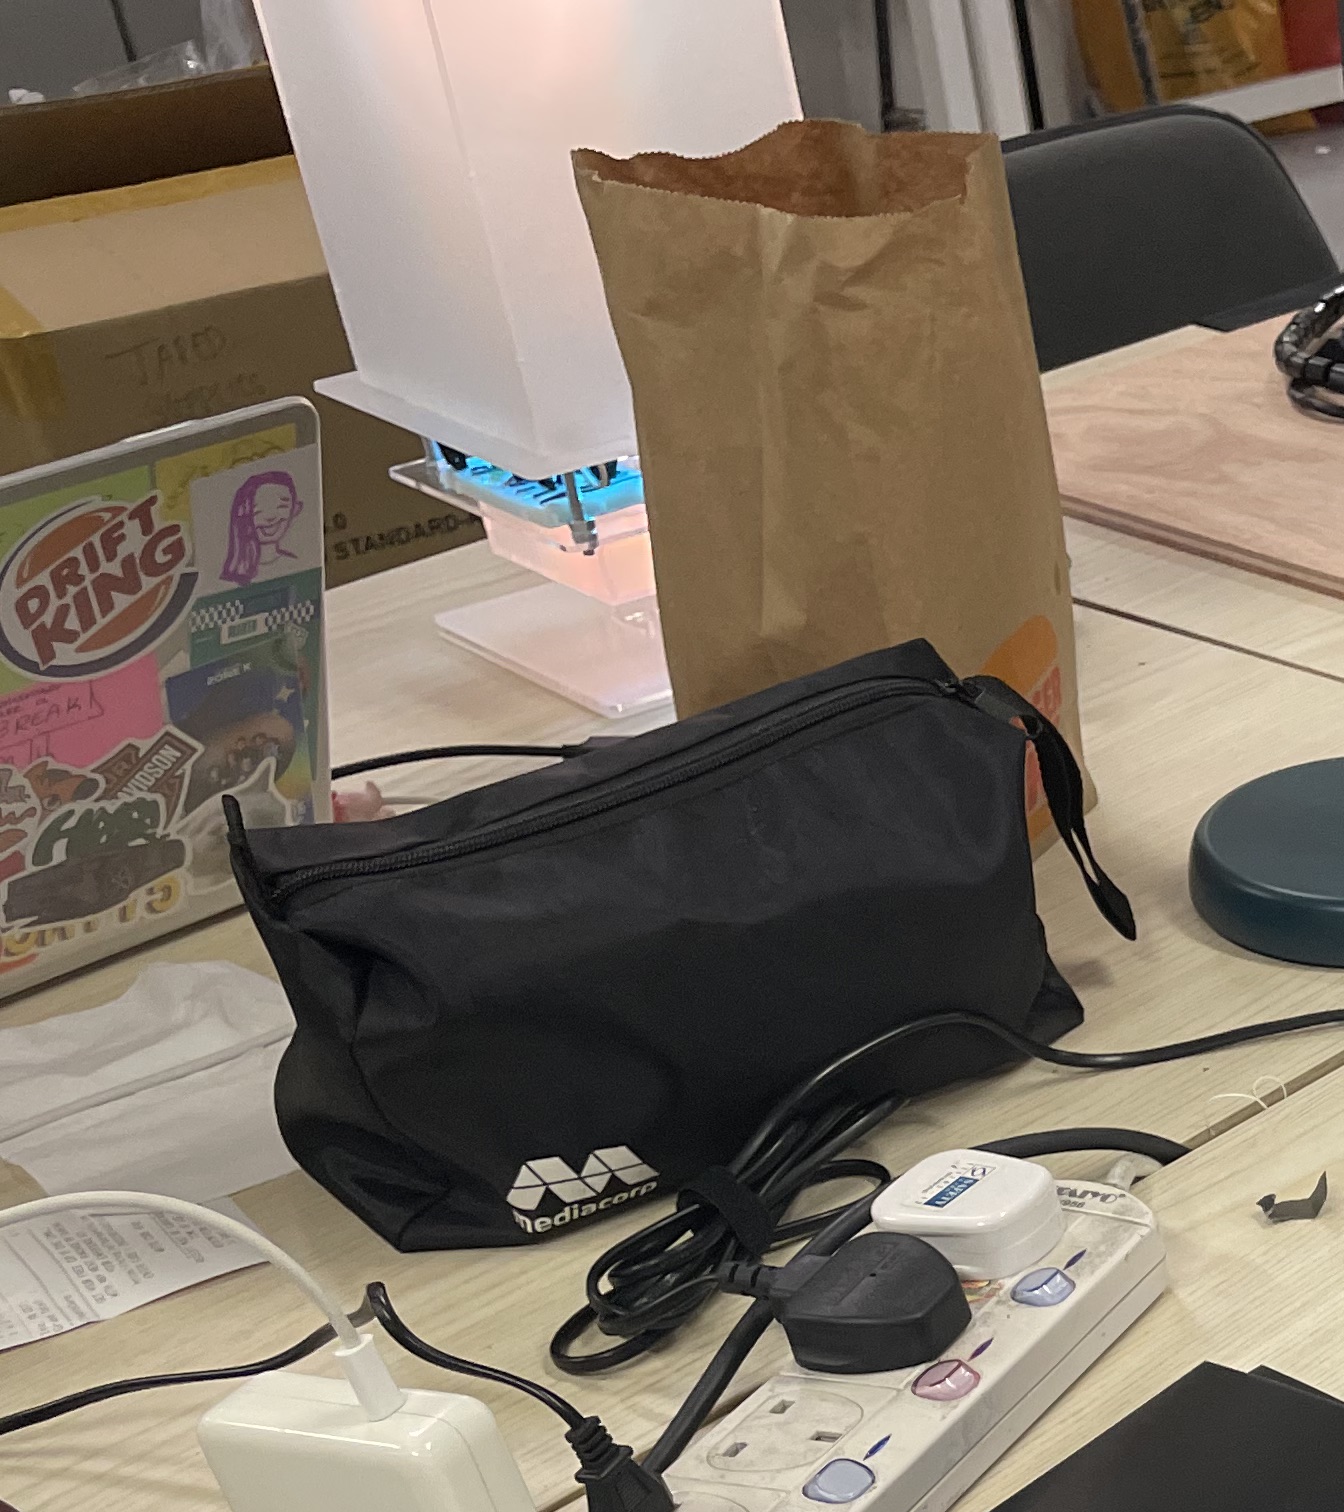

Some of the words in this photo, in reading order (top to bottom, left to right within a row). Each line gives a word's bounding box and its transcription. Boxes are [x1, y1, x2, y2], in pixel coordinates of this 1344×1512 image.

[15, 494, 159, 631] DRIFT
[31, 523, 187, 669] KING
[512, 1181, 658, 1234] mediacorp
